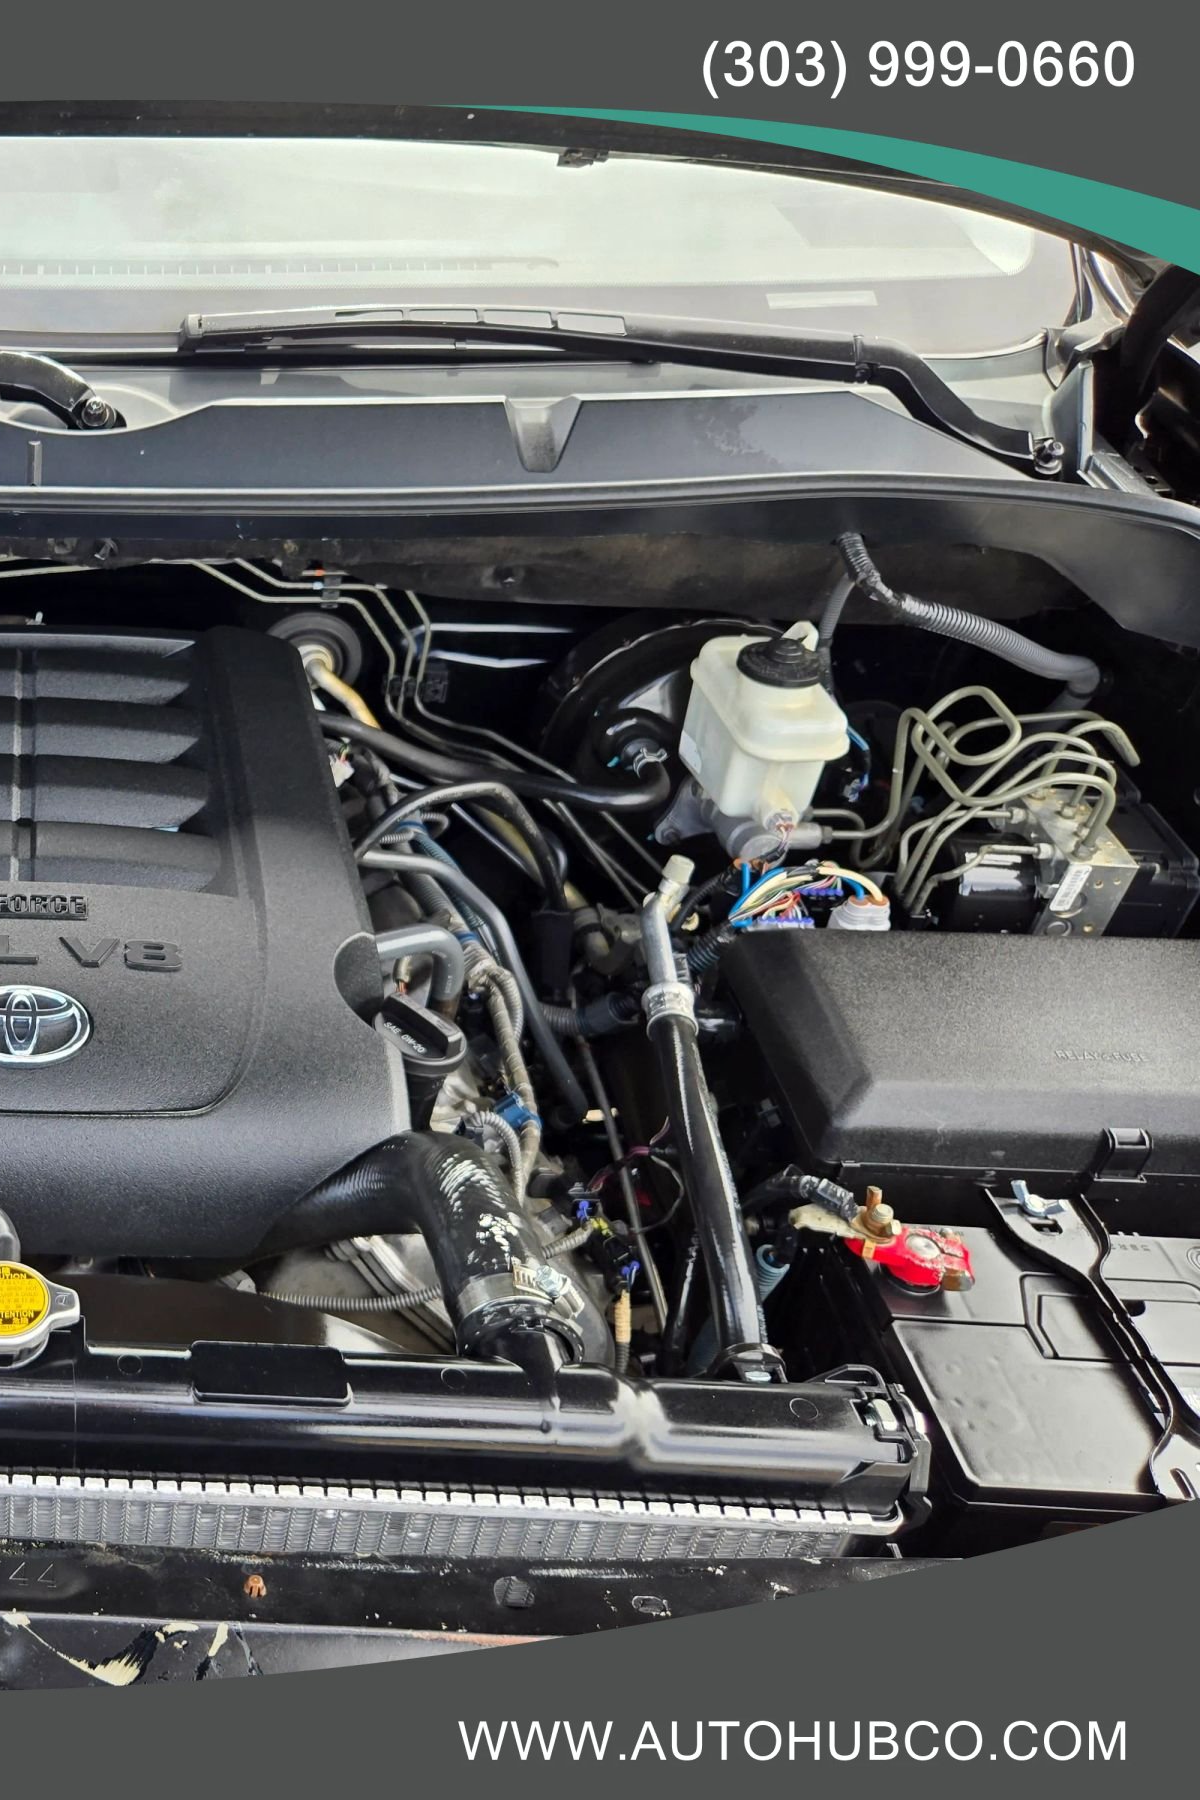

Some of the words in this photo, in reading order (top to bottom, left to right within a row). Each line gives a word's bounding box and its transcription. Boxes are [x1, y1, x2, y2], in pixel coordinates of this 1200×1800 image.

[59, 936, 182, 970] V8
[384, 1022, 401, 1034] SAE
[401, 1034, 427, 1053] 0W-20
